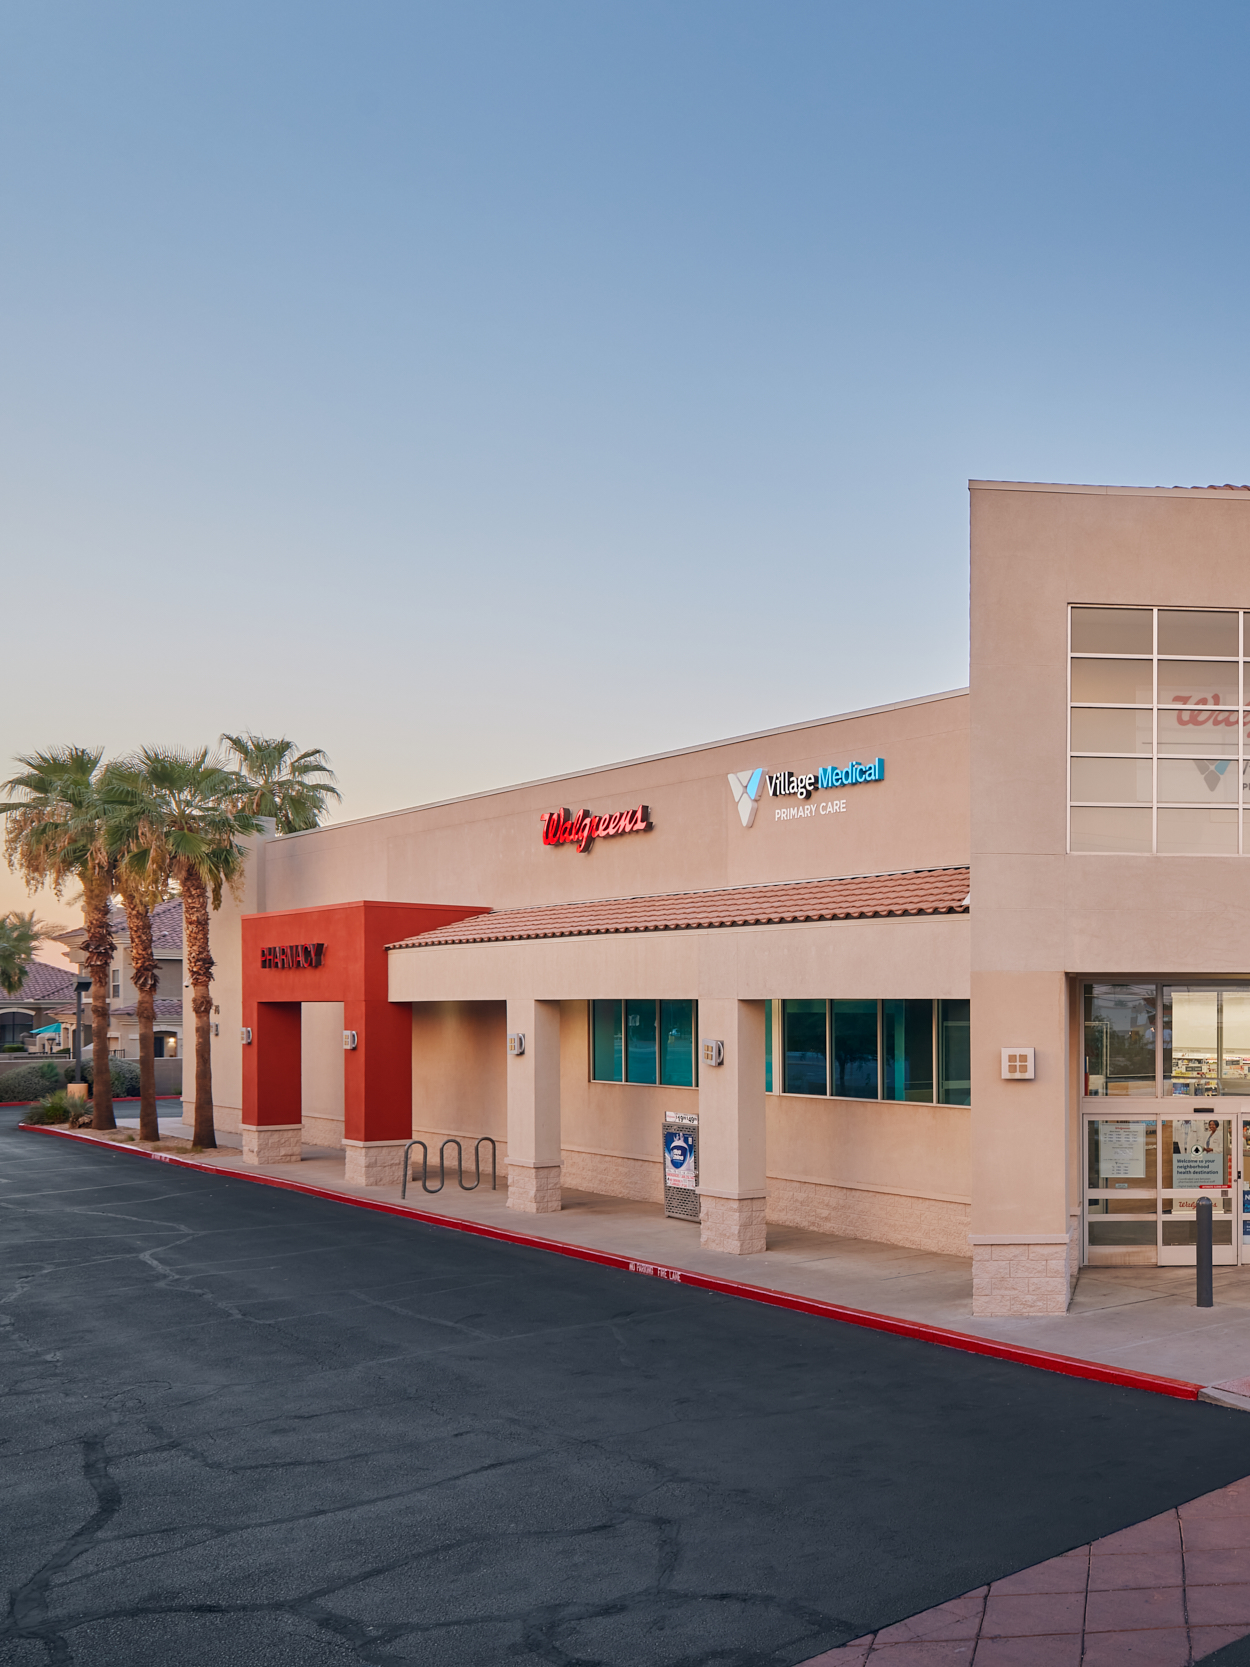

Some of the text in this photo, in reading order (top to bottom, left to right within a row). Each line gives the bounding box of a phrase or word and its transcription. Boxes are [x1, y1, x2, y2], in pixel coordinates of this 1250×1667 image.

[766, 757, 885, 800] Village Medical
[775, 800, 847, 822] PRIMARY CARE
[540, 804, 652, 853] Walgreens
[260, 943, 324, 969] PHARMACY
[1178, 1201, 1217, 1209] Walgs
[629, 1262, 681, 1282] NO PARKING FIRE LANE
